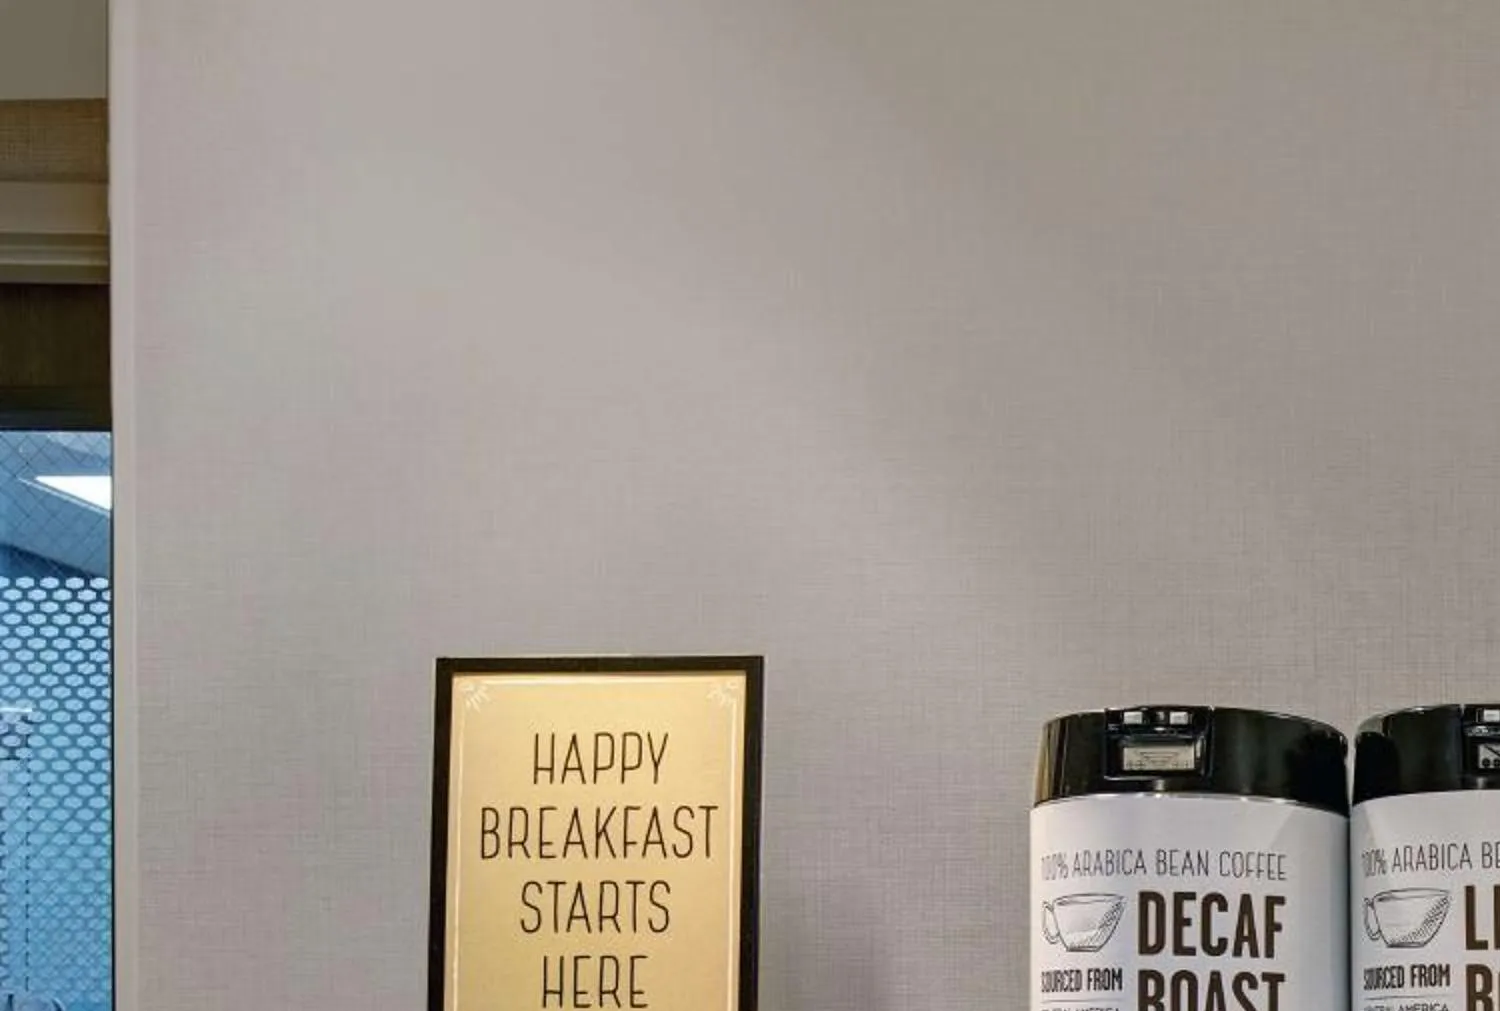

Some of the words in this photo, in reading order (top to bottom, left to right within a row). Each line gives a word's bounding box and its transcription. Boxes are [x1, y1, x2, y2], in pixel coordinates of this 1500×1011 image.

[533, 732, 669, 785] HAPPY
[479, 805, 719, 860] BREAKFAST
[1391, 842, 1473, 873] ARABICA
[1071, 849, 1148, 878] ARABICA
[1155, 849, 1209, 877] BEAN
[1218, 851, 1288, 881] COFFEE
[519, 879, 671, 934] STARTS
[1137, 891, 1286, 959] DECAF
[541, 955, 650, 1009] HERE
[1087, 968, 1123, 991] FROM
[1410, 963, 1451, 988] FROM
